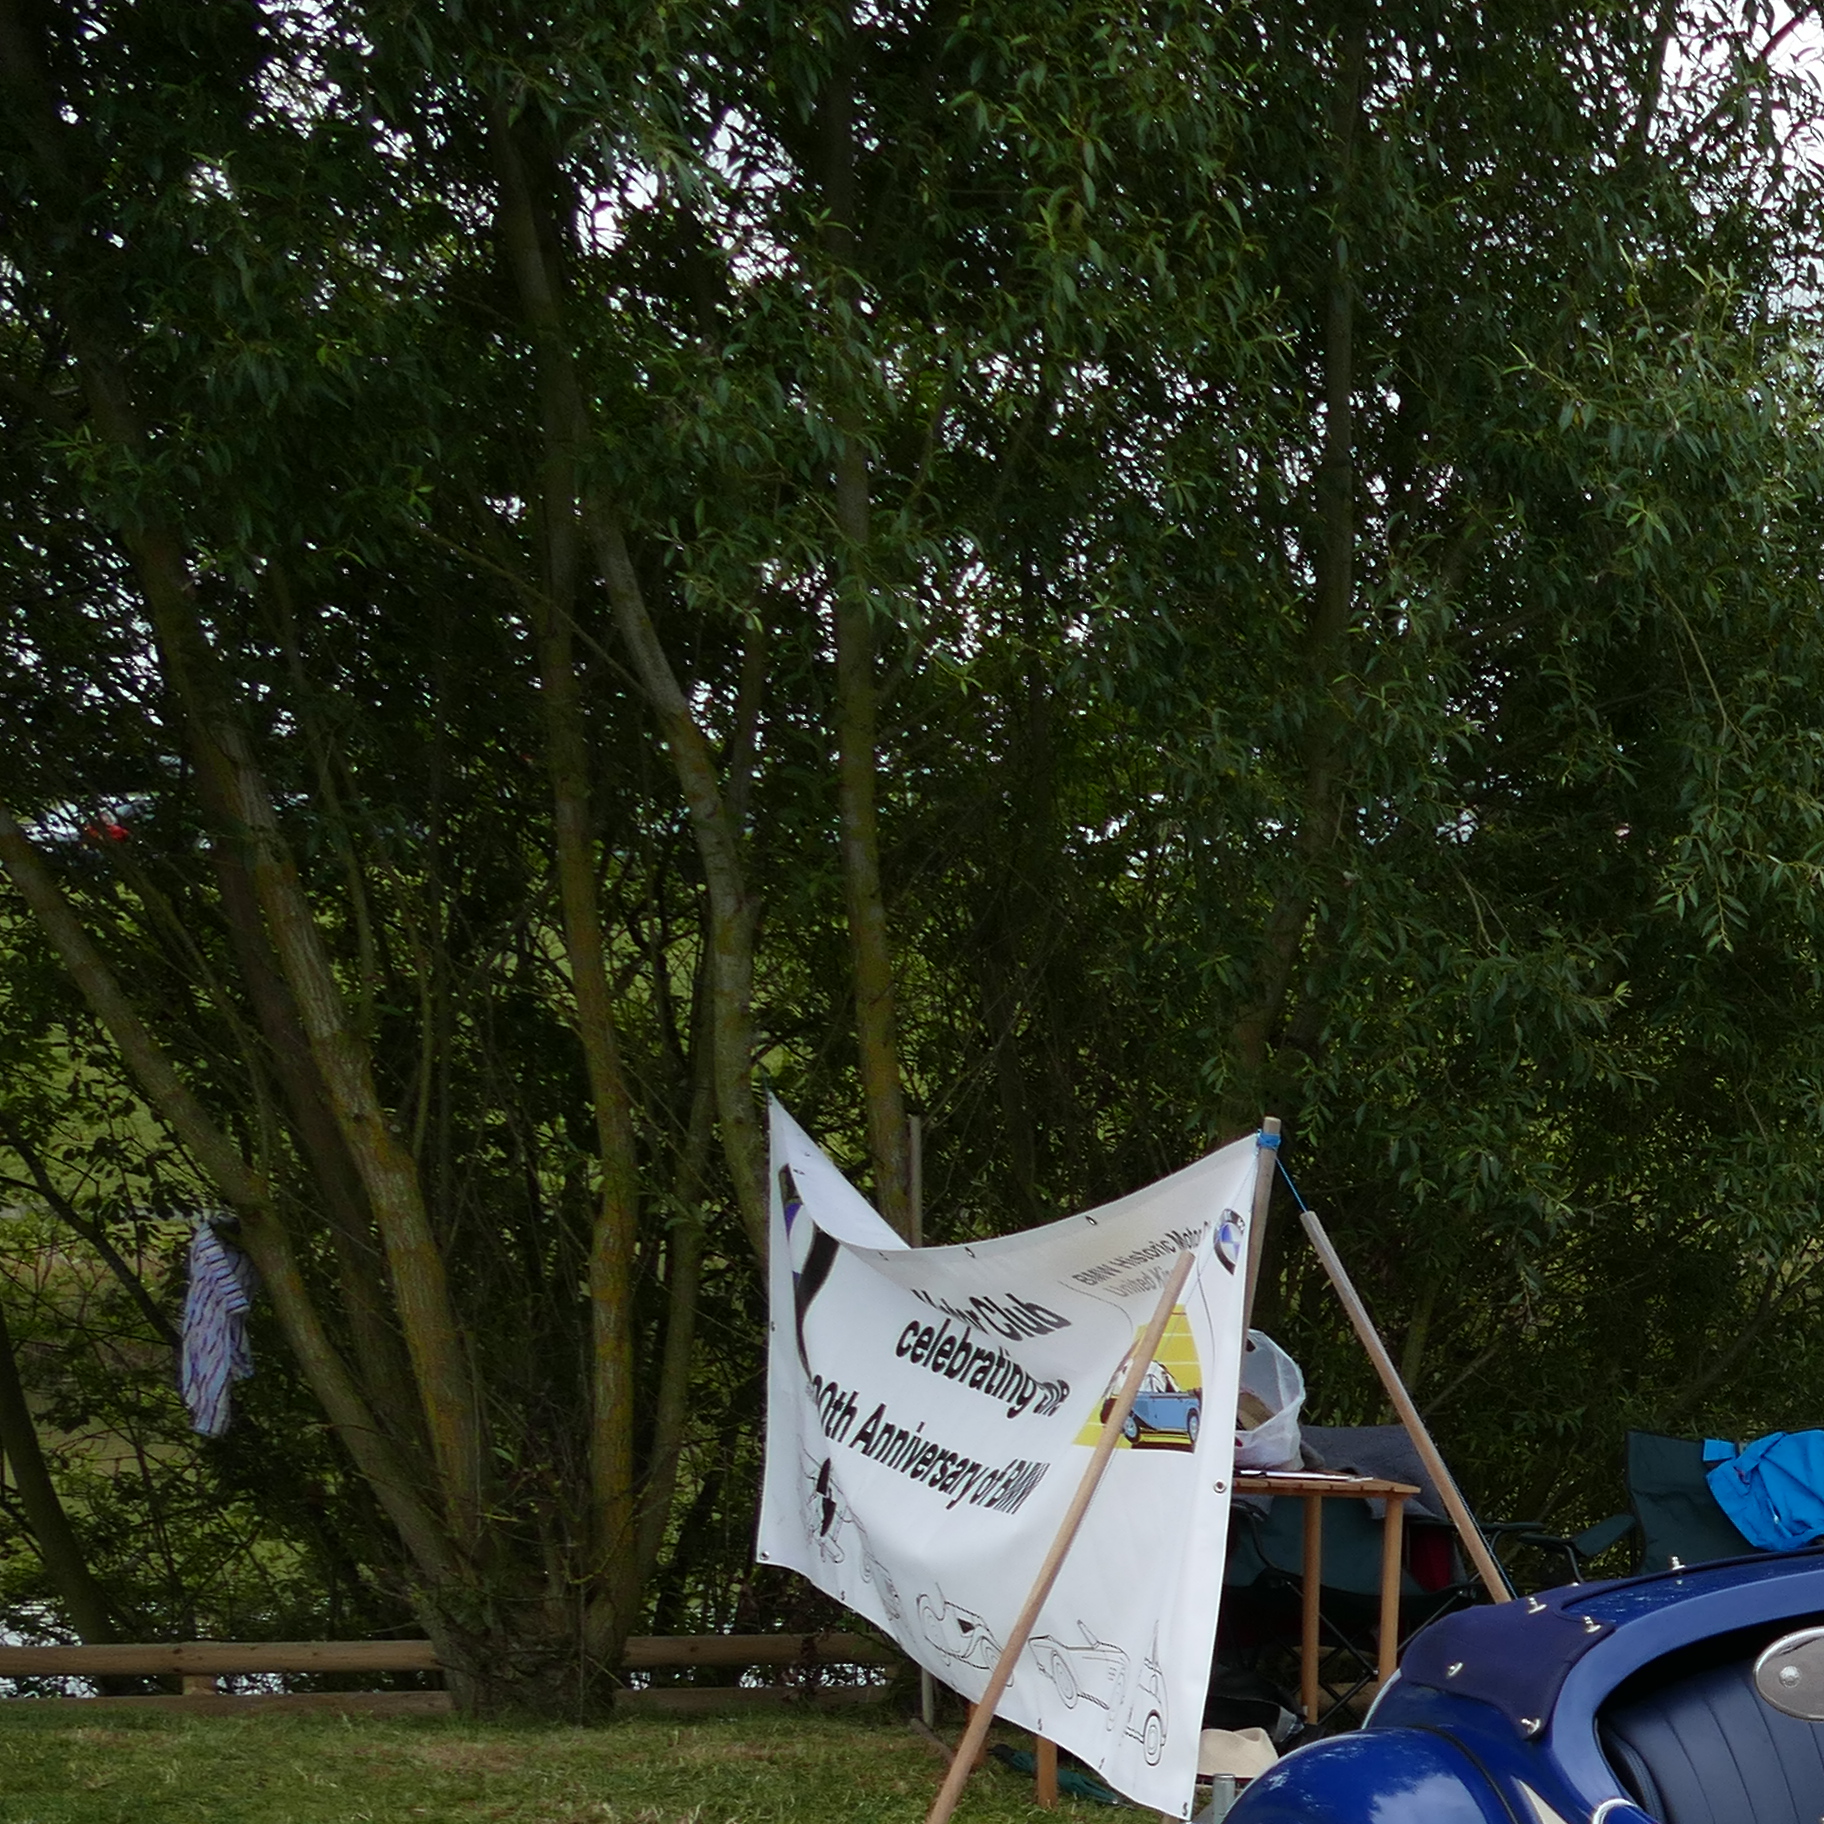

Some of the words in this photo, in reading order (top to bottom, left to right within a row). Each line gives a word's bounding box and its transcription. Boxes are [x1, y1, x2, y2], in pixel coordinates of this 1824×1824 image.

[969, 1293, 1072, 1341] Club
[895, 1318, 1037, 1419] celebrating
[849, 1403, 988, 1510] Anniversary
